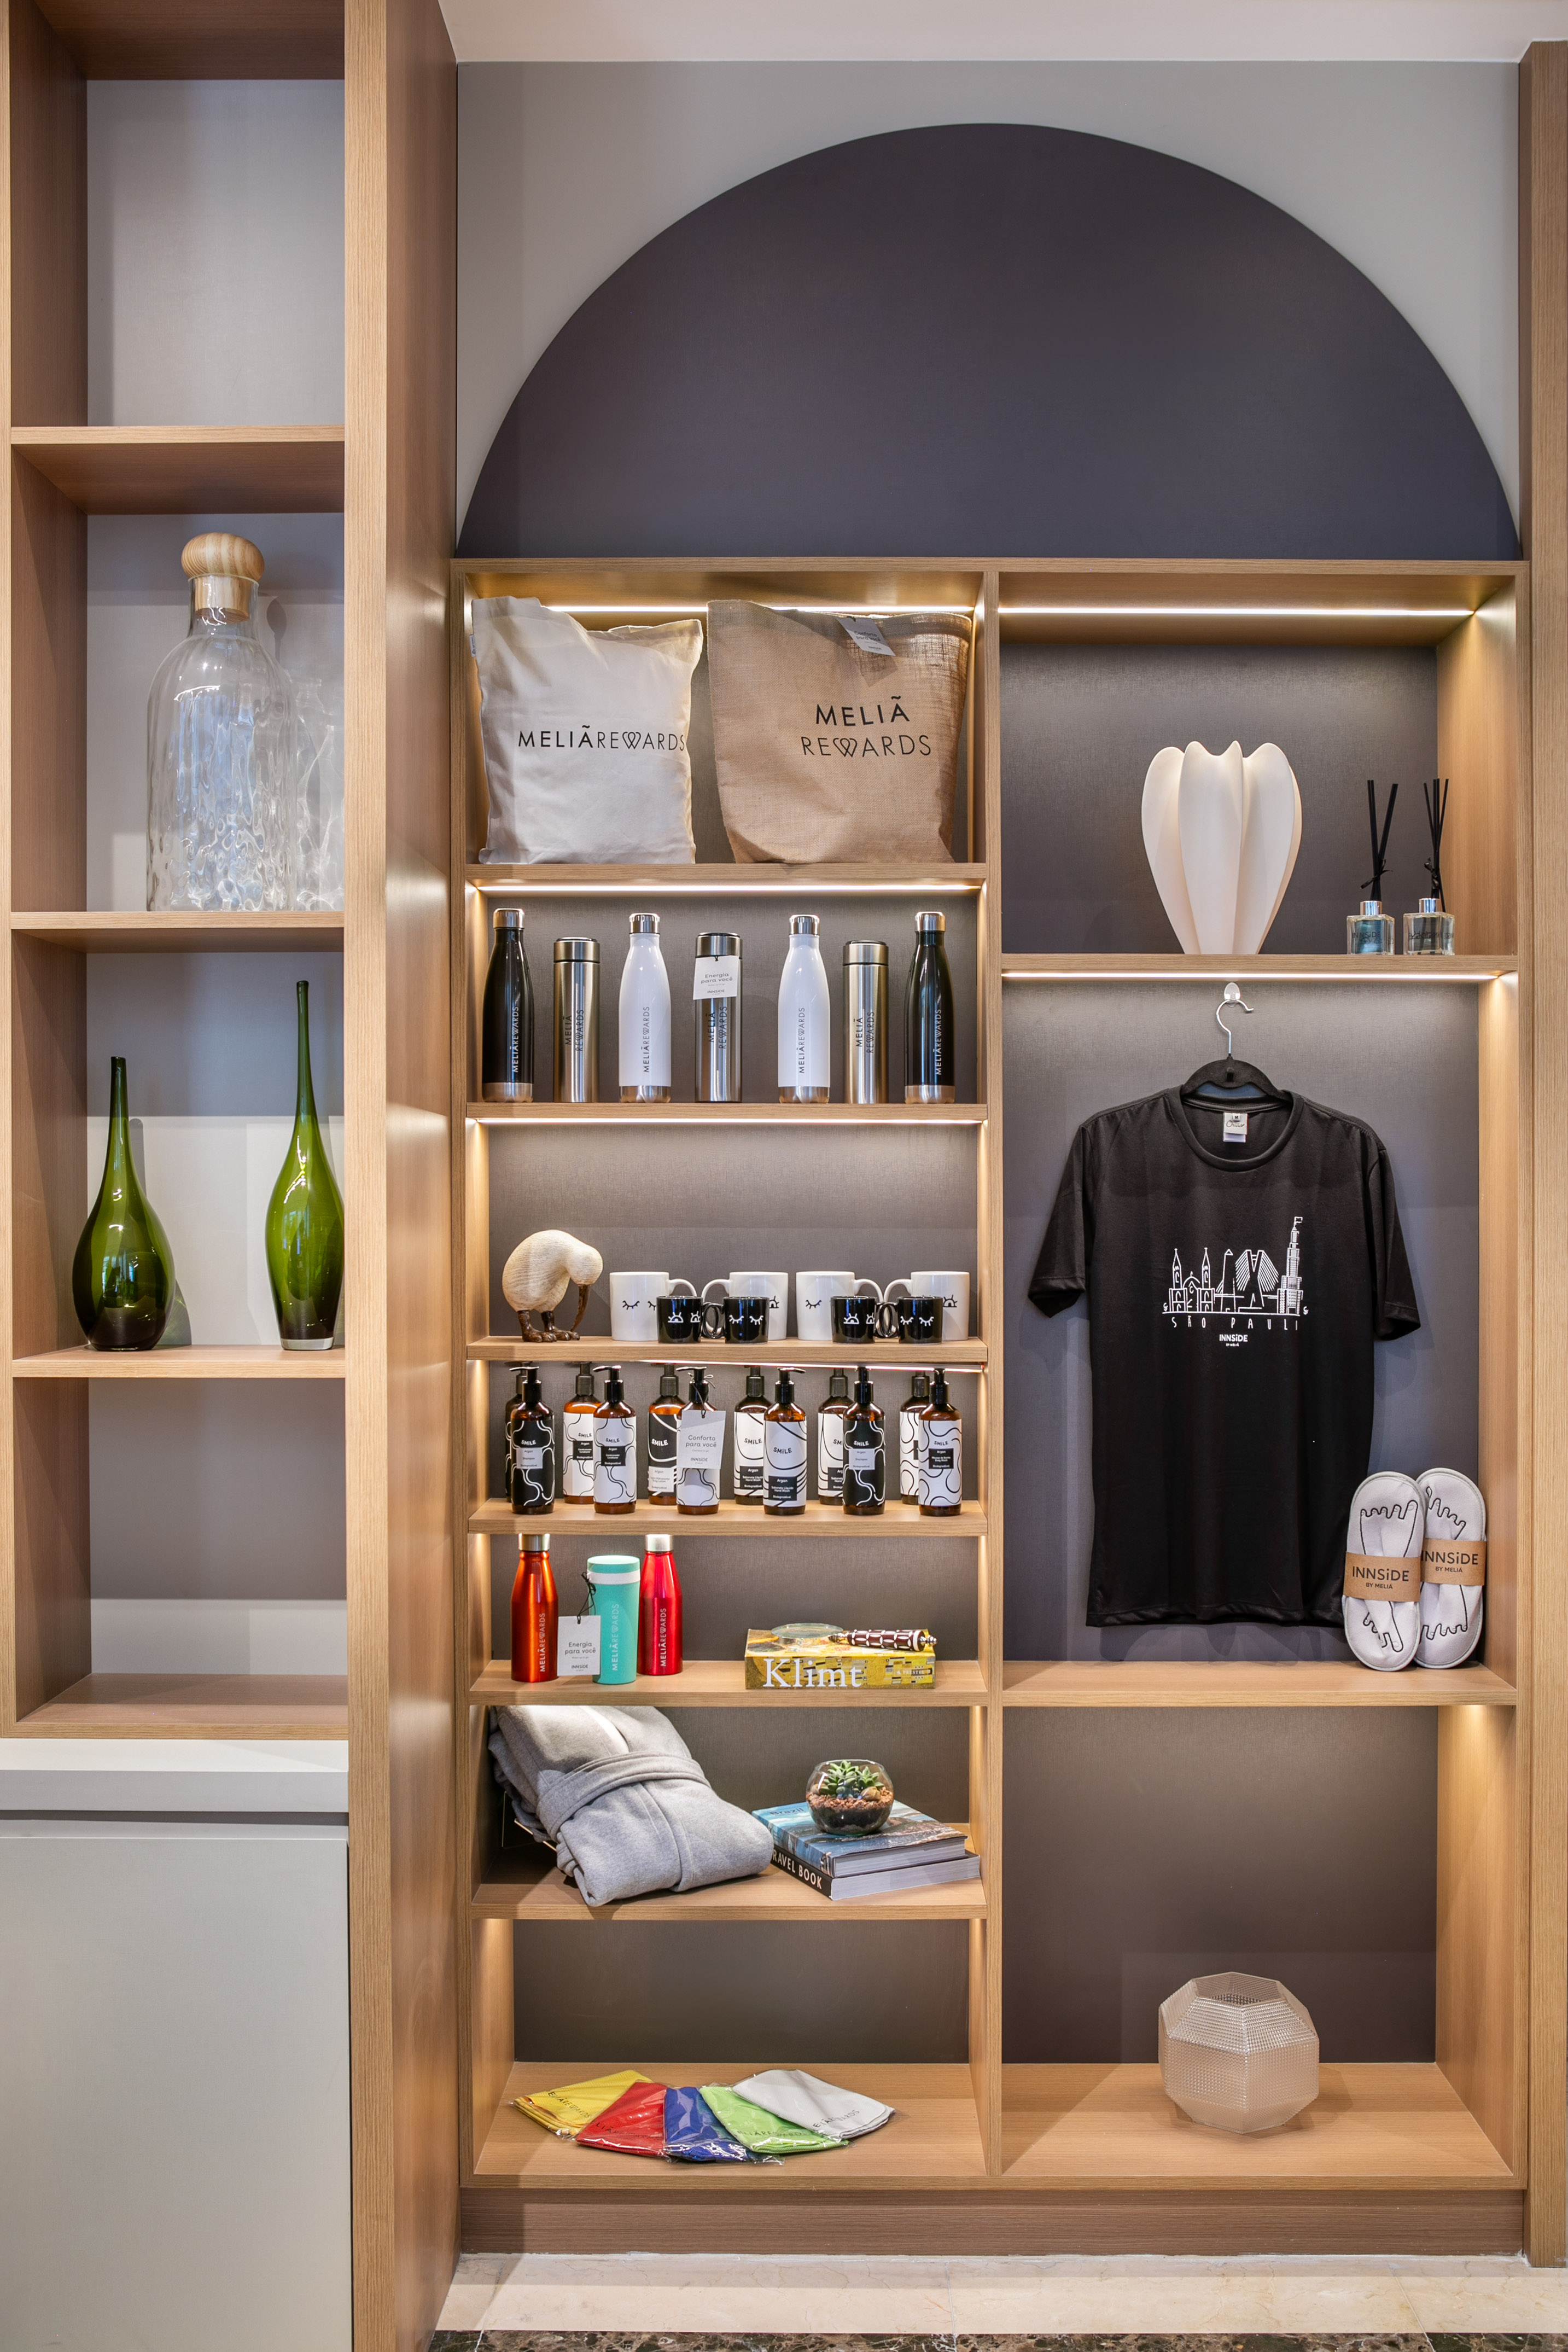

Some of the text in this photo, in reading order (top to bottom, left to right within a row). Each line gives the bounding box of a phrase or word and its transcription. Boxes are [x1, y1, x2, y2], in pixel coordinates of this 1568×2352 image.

[801, 735, 931, 758] REWARDS
[575, 1009, 584, 1051] REWARDS
[718, 1006, 727, 1049] REWARDS
[866, 1011, 875, 1053] REWARDS
[1171, 1315, 1206, 1328] SÃO
[762, 1657, 864, 1687] Klimt
[772, 1849, 822, 1889] RAVEL BOOK
